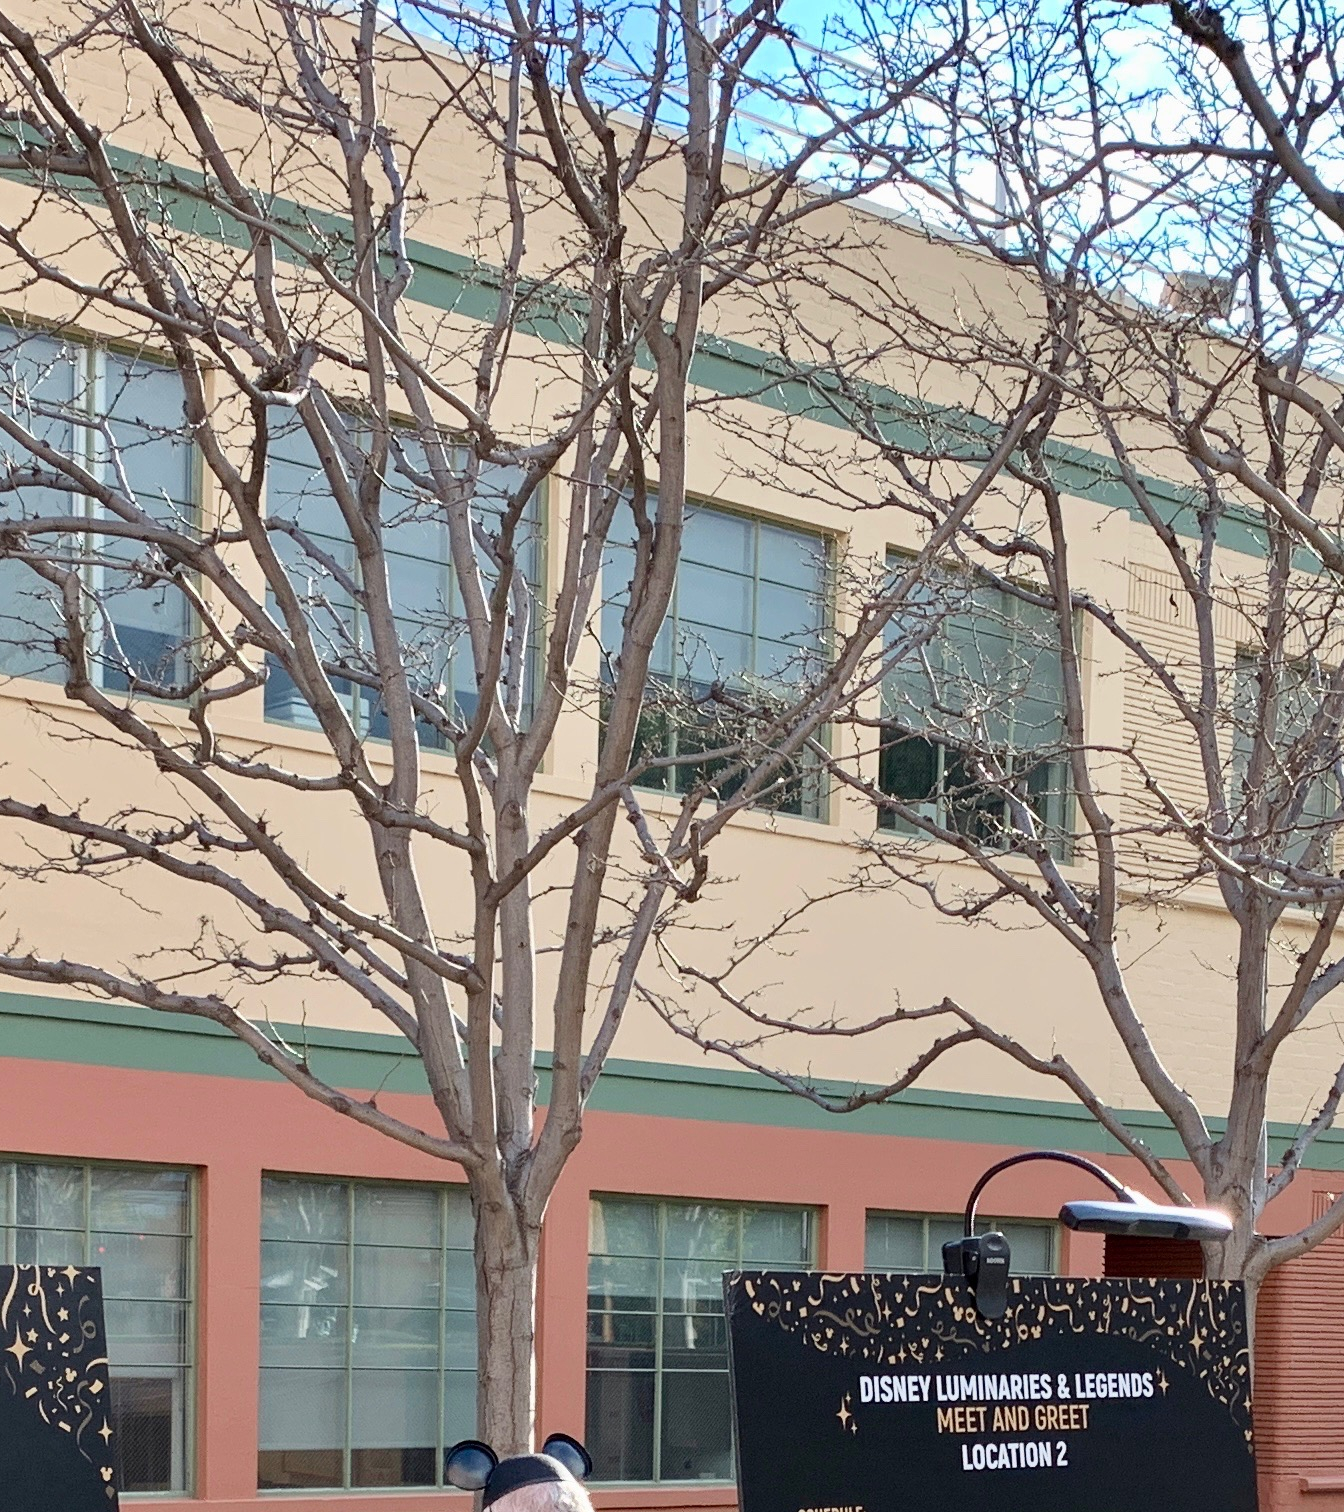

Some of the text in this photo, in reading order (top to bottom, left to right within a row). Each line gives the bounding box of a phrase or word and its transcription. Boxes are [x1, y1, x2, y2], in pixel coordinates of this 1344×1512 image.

[859, 1371, 1154, 1404] DISNEY LUMINARIES & LEGENDS
[936, 1403, 1091, 1434] MEET AND GREET
[961, 1441, 1069, 1472] LOCATION 2
